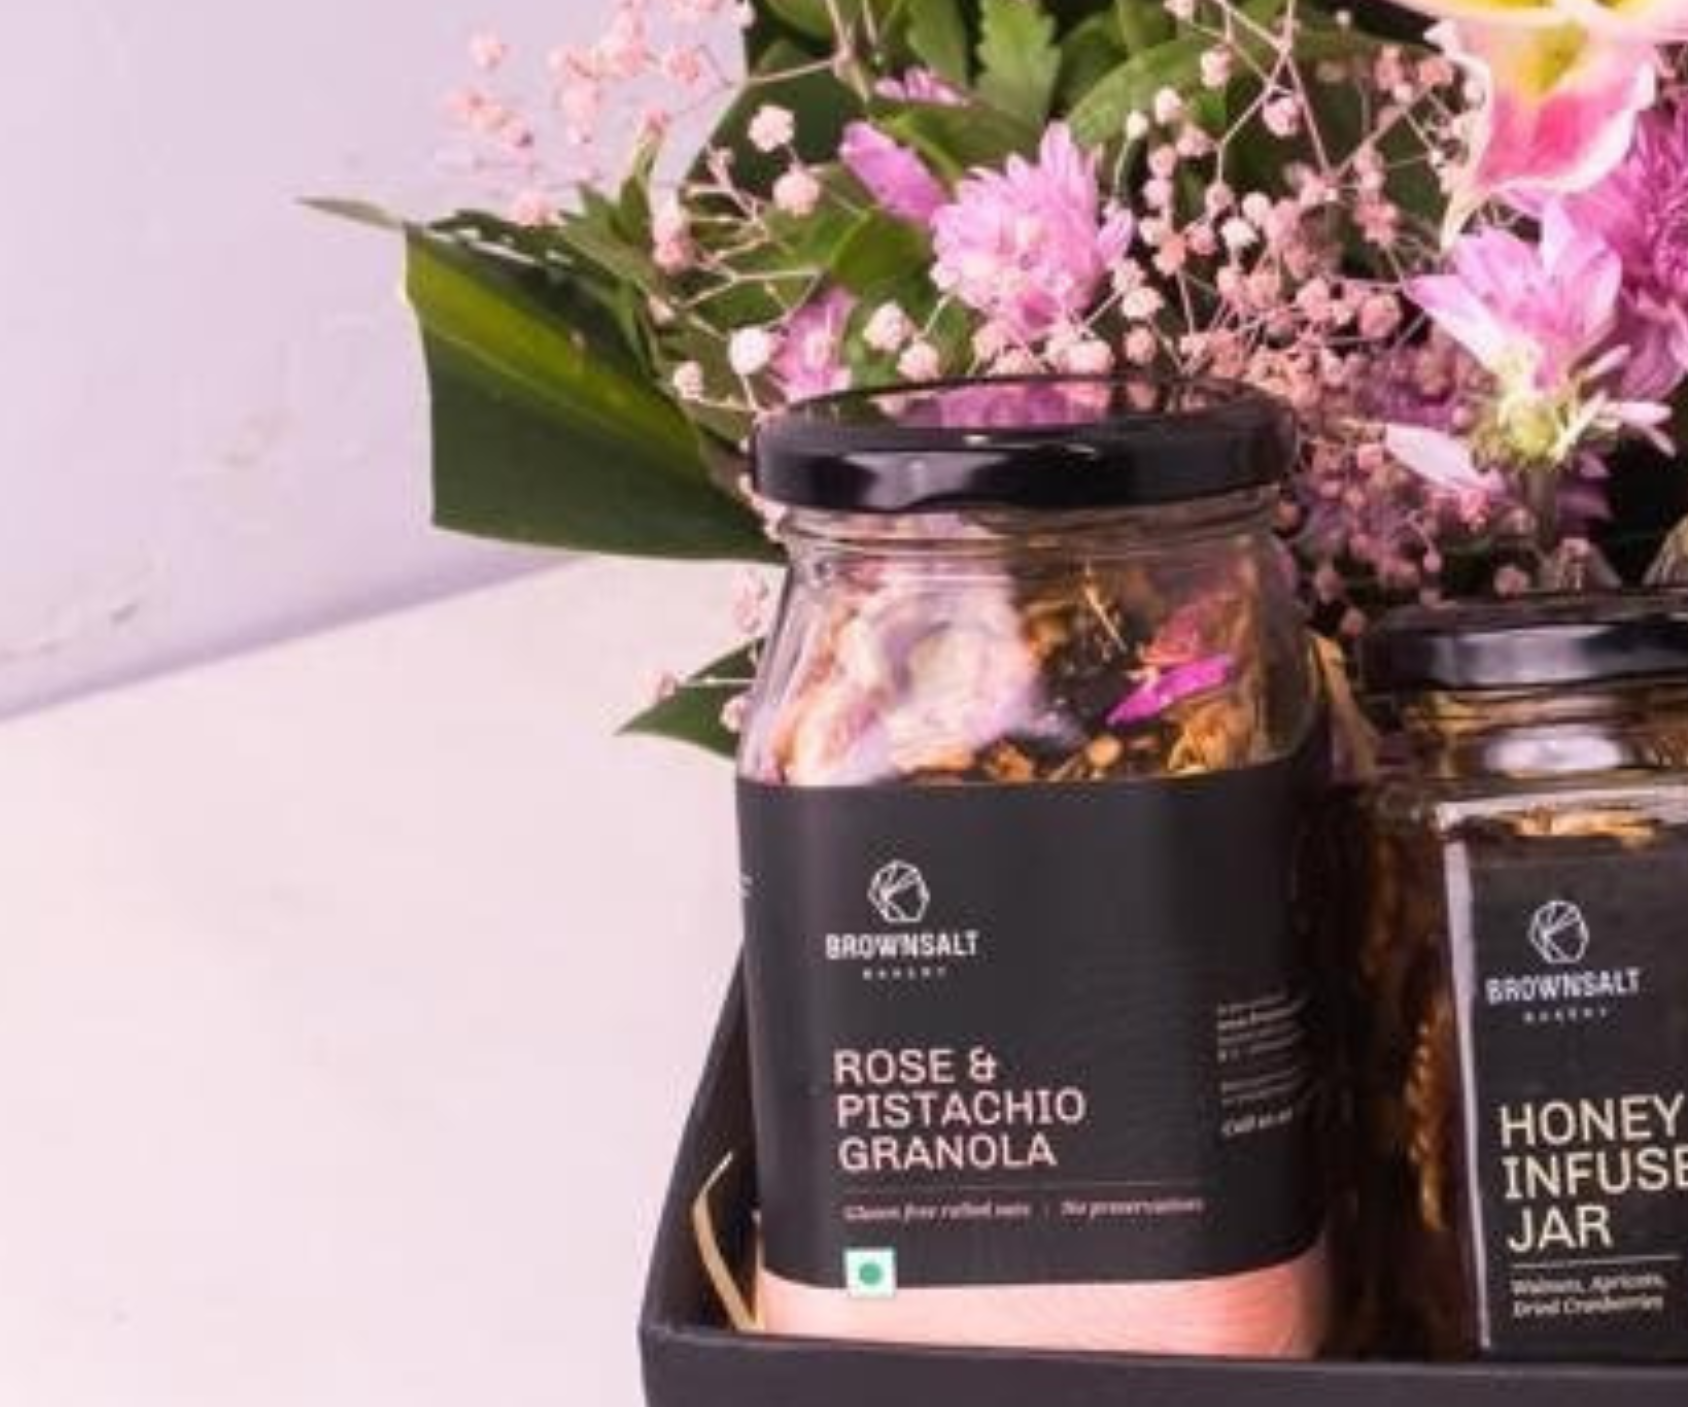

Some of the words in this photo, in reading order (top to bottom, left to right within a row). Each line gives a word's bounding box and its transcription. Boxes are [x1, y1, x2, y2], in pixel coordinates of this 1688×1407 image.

[826, 929, 979, 960] BROWNSALT
[1486, 967, 1641, 1005] BROWNSALT
[832, 1049, 955, 1084] ROSE
[968, 1046, 997, 1080] &
[836, 1087, 1087, 1128] PISTACHIO
[1501, 1093, 1685, 1149] HONEY
[838, 1134, 1057, 1172] GRANOLA
[1507, 1204, 1614, 1252] JAR
